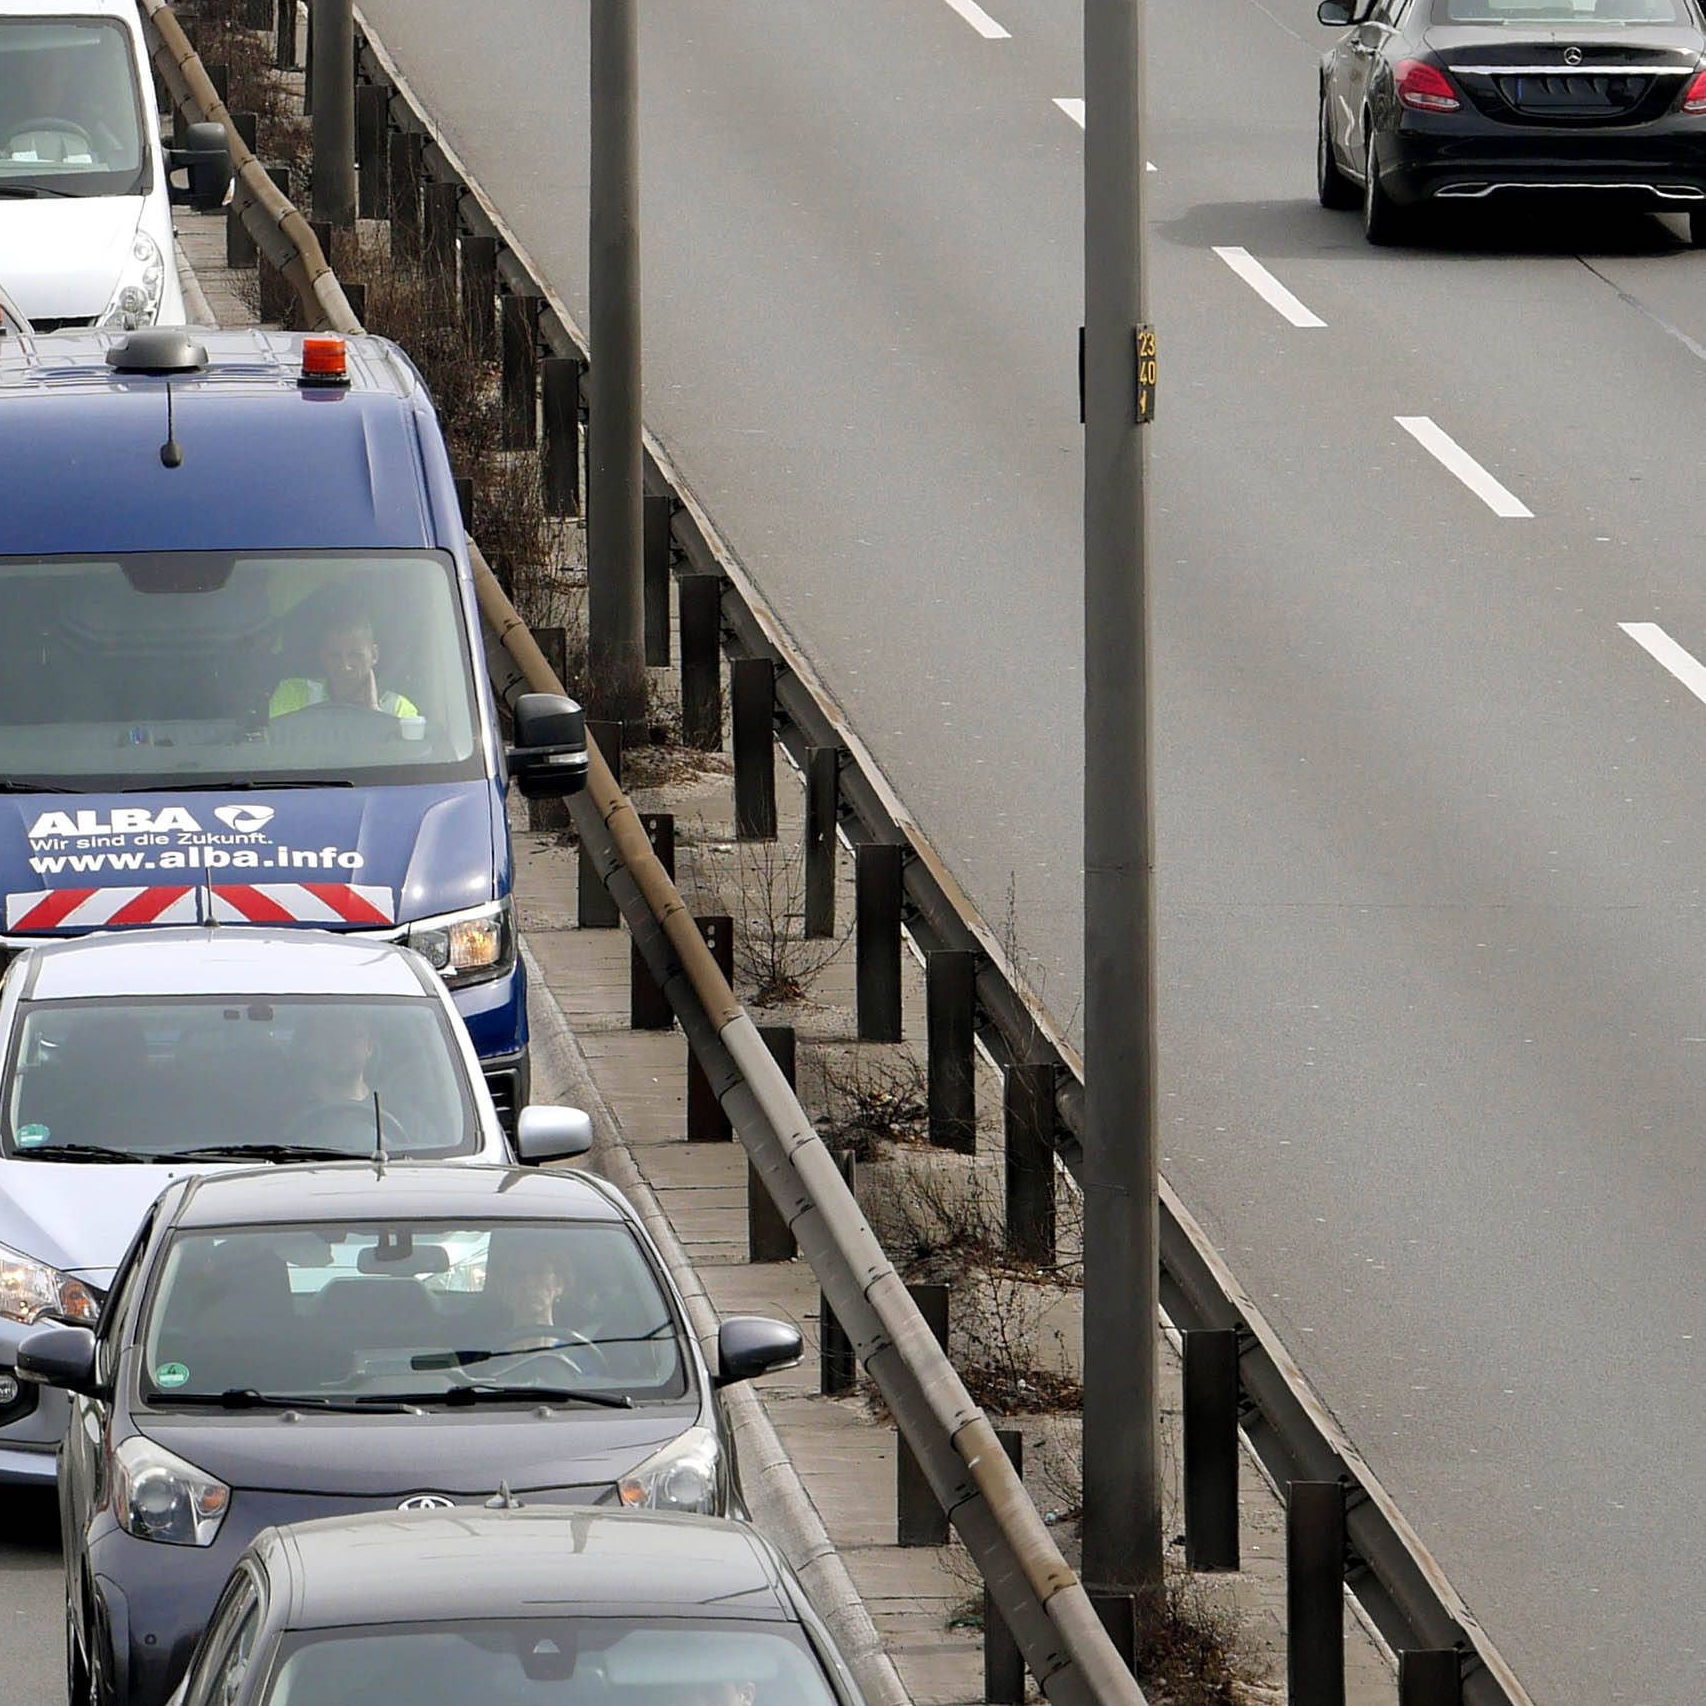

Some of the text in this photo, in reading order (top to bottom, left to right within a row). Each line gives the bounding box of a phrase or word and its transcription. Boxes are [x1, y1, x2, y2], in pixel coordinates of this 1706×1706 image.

[1139, 332, 1156, 356] 23
[1139, 360, 1156, 385] 40
[27, 807, 202, 838] ALBA
[29, 831, 274, 852] Wir sind die Zukunft.
[28, 846, 365, 875] www.alba.info
